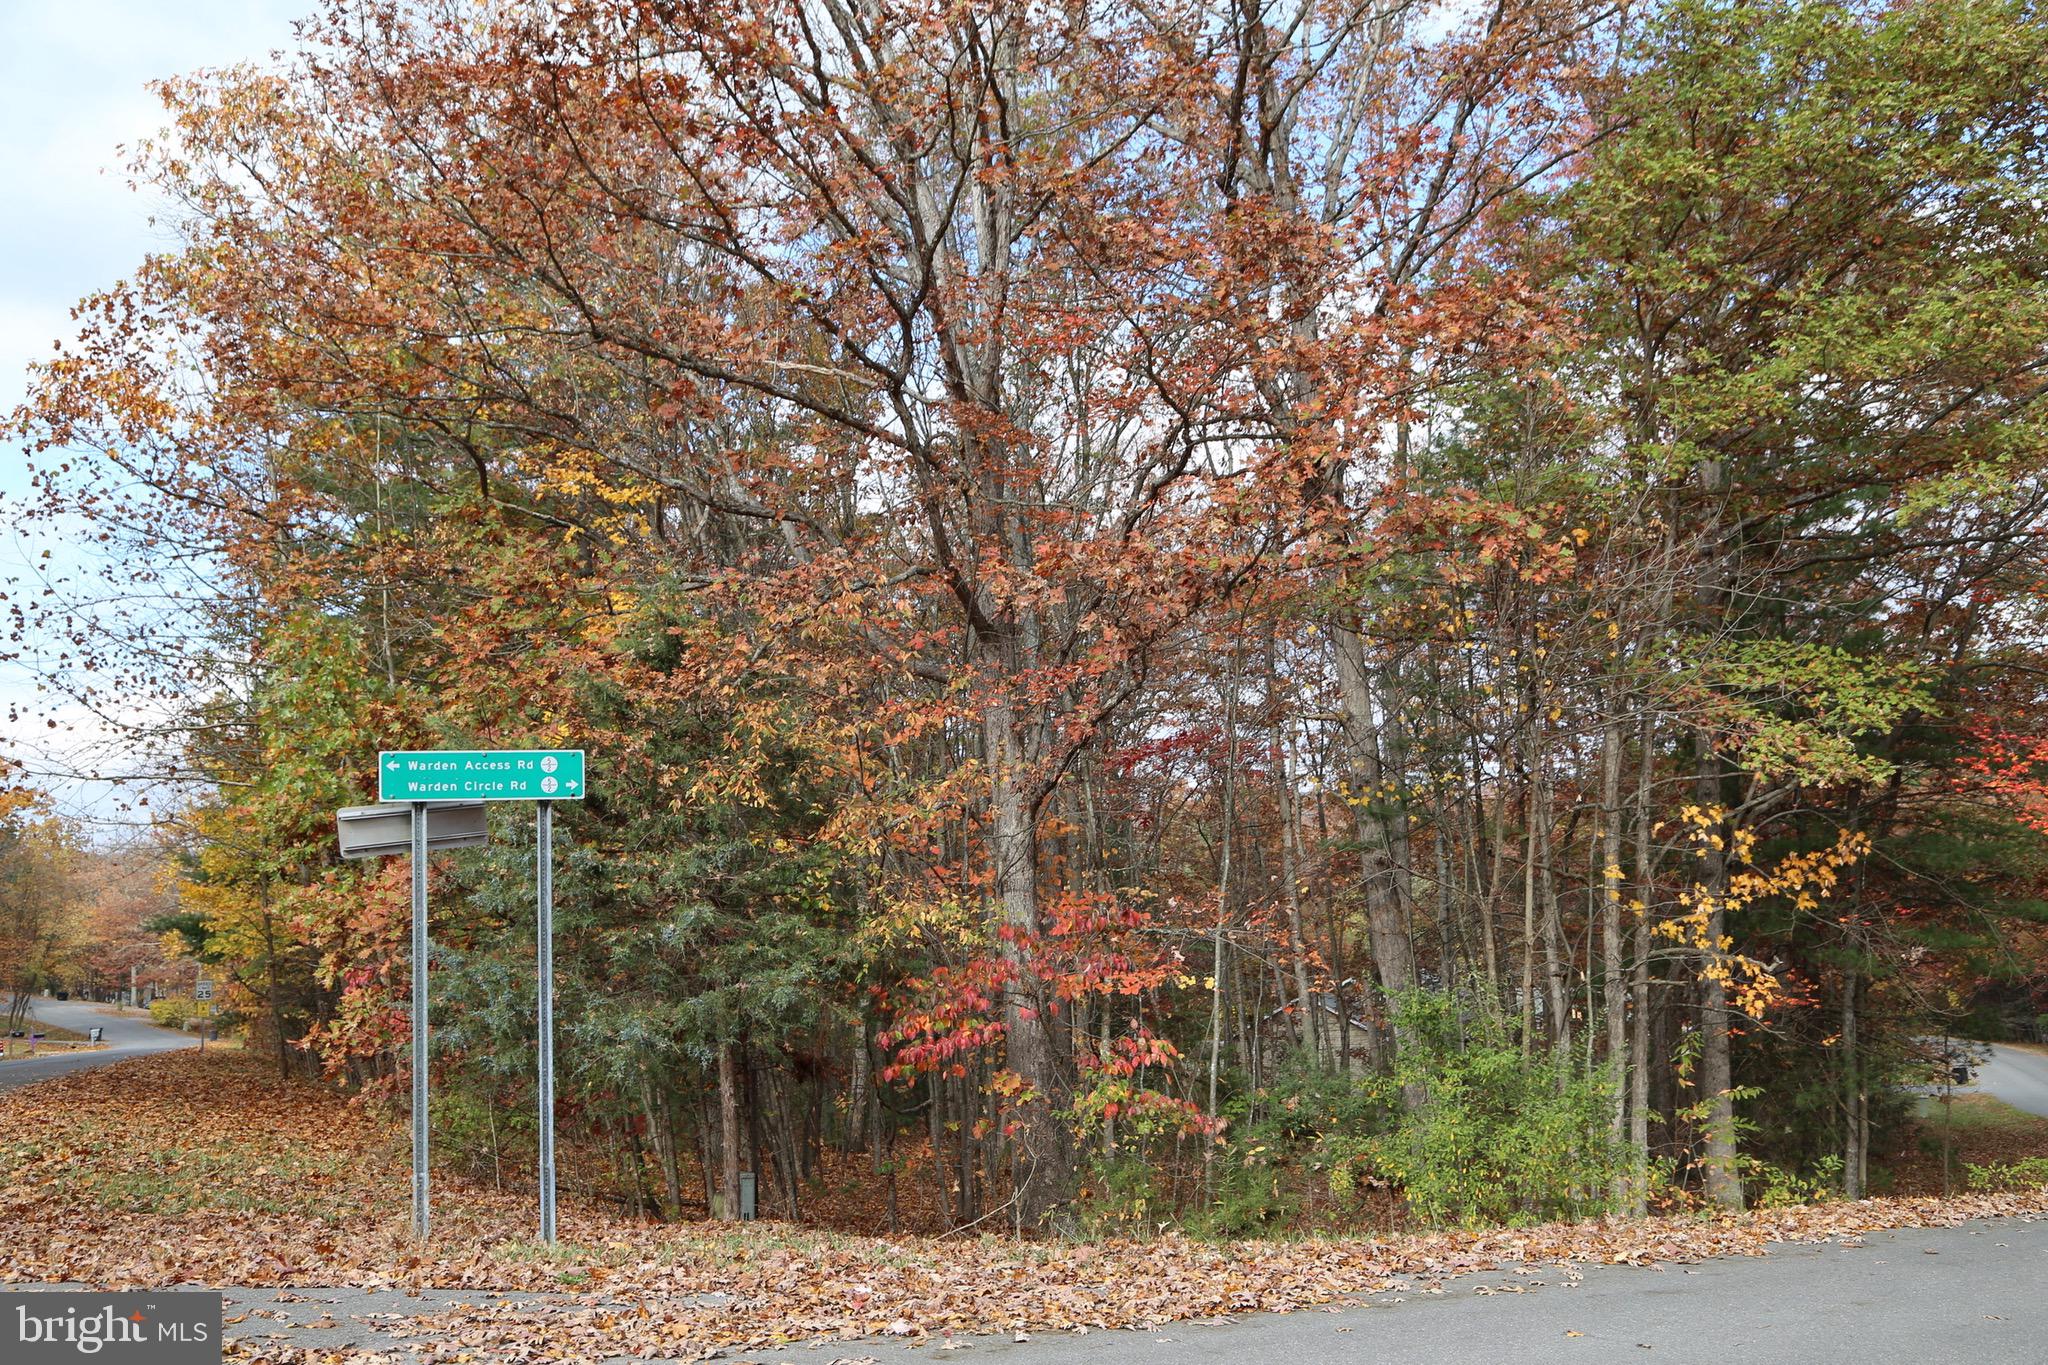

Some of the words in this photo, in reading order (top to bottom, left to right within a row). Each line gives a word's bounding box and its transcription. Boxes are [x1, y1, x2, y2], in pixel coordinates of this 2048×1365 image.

[408, 760, 457, 771] Warden
[465, 760, 511, 771] Access
[517, 759, 534, 770] Rd
[408, 781, 457, 792] Warden
[465, 780, 504, 791] Circle
[511, 780, 527, 791] Rd
[197, 990, 211, 998] 25
